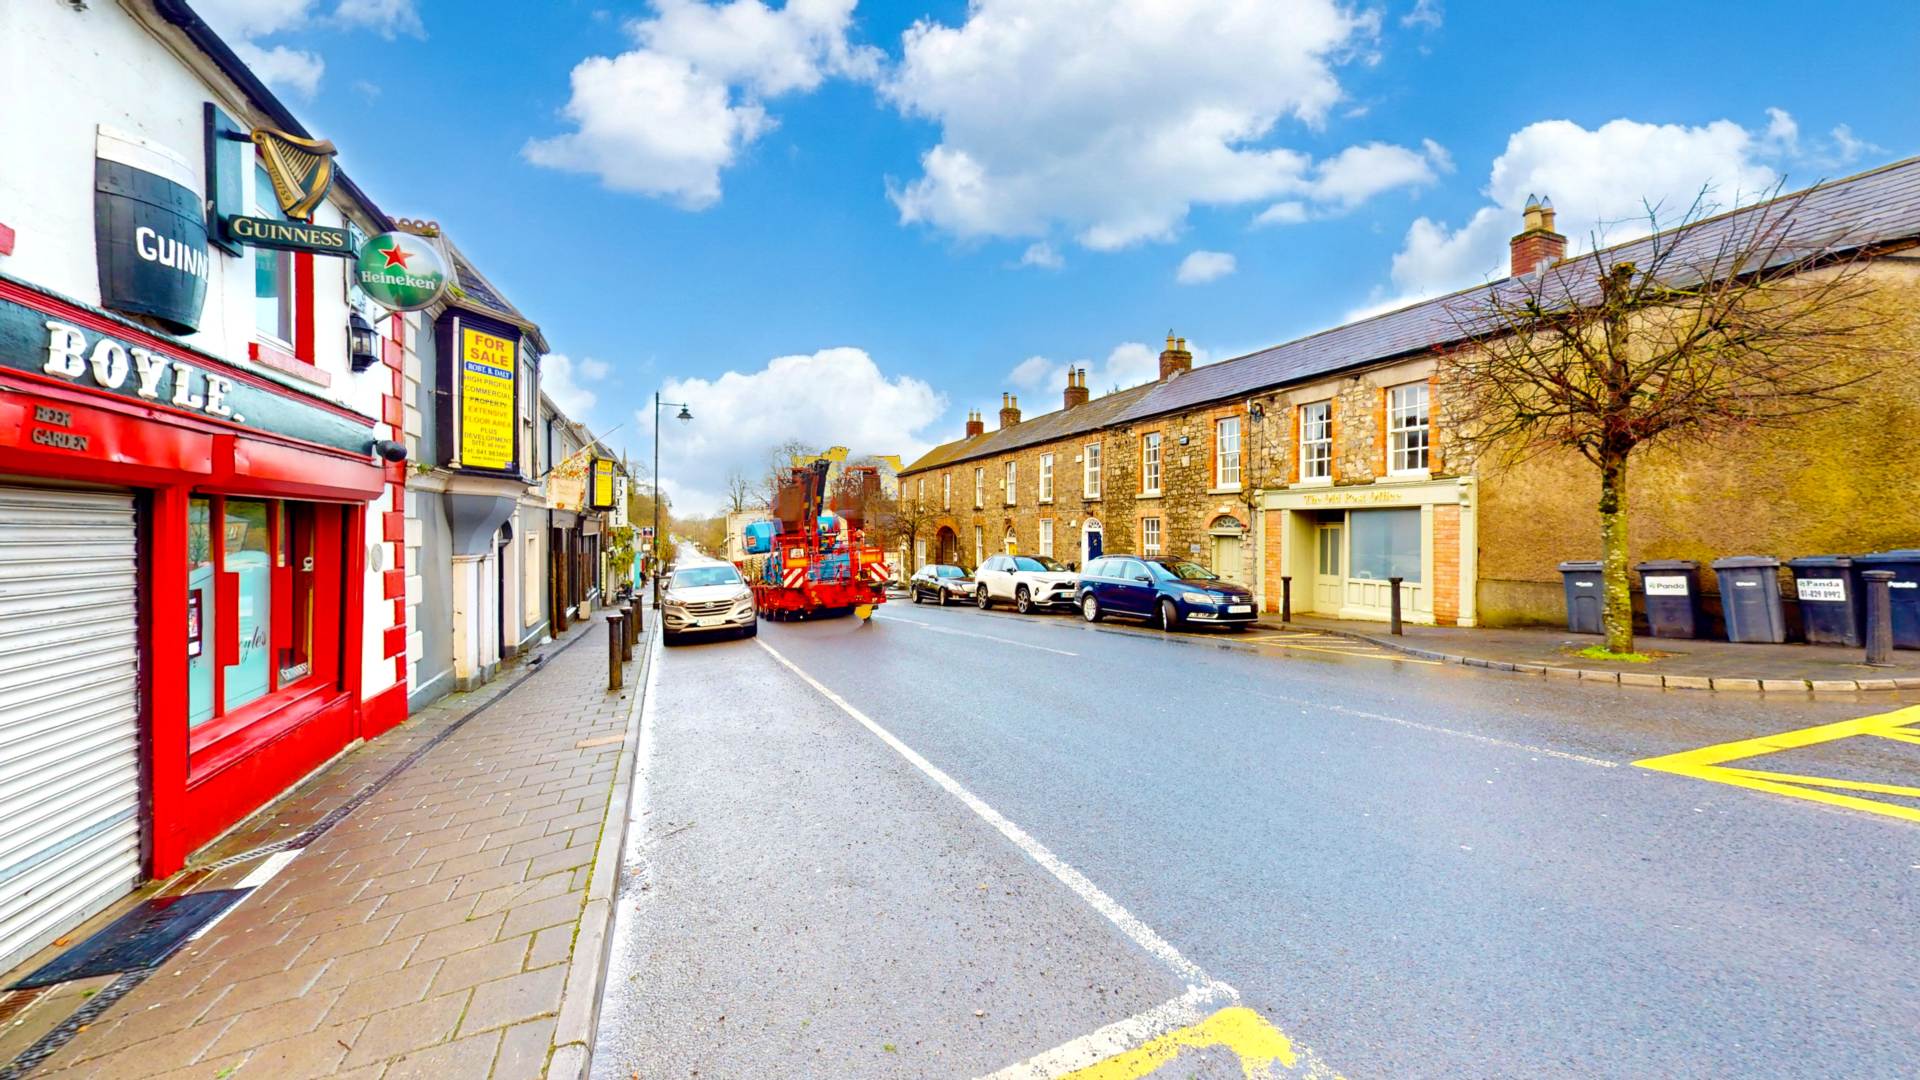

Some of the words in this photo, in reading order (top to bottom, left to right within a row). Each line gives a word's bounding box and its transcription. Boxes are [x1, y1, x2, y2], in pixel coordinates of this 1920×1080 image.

[233, 217, 344, 247] GUINNESS
[136, 226, 208, 283] GUINN
[361, 270, 437, 290] Heineken
[475, 334, 505, 352] FOR
[470, 347, 509, 367] SALE
[483, 378, 512, 391] PROFILE
[464, 385, 511, 400] COMMERCIAL
[469, 396, 507, 408] PROPERTY
[468, 405, 508, 418] EXTENSIVE
[464, 415, 490, 425] FLOOR
[492, 419, 512, 428] AREA
[464, 432, 512, 444] DEVELOPMENT
[480, 427, 497, 435] PLUS
[32, 427, 89, 451] GARDEN
[1656, 582, 1685, 590] Panda
[240, 626, 266, 664] yle's
